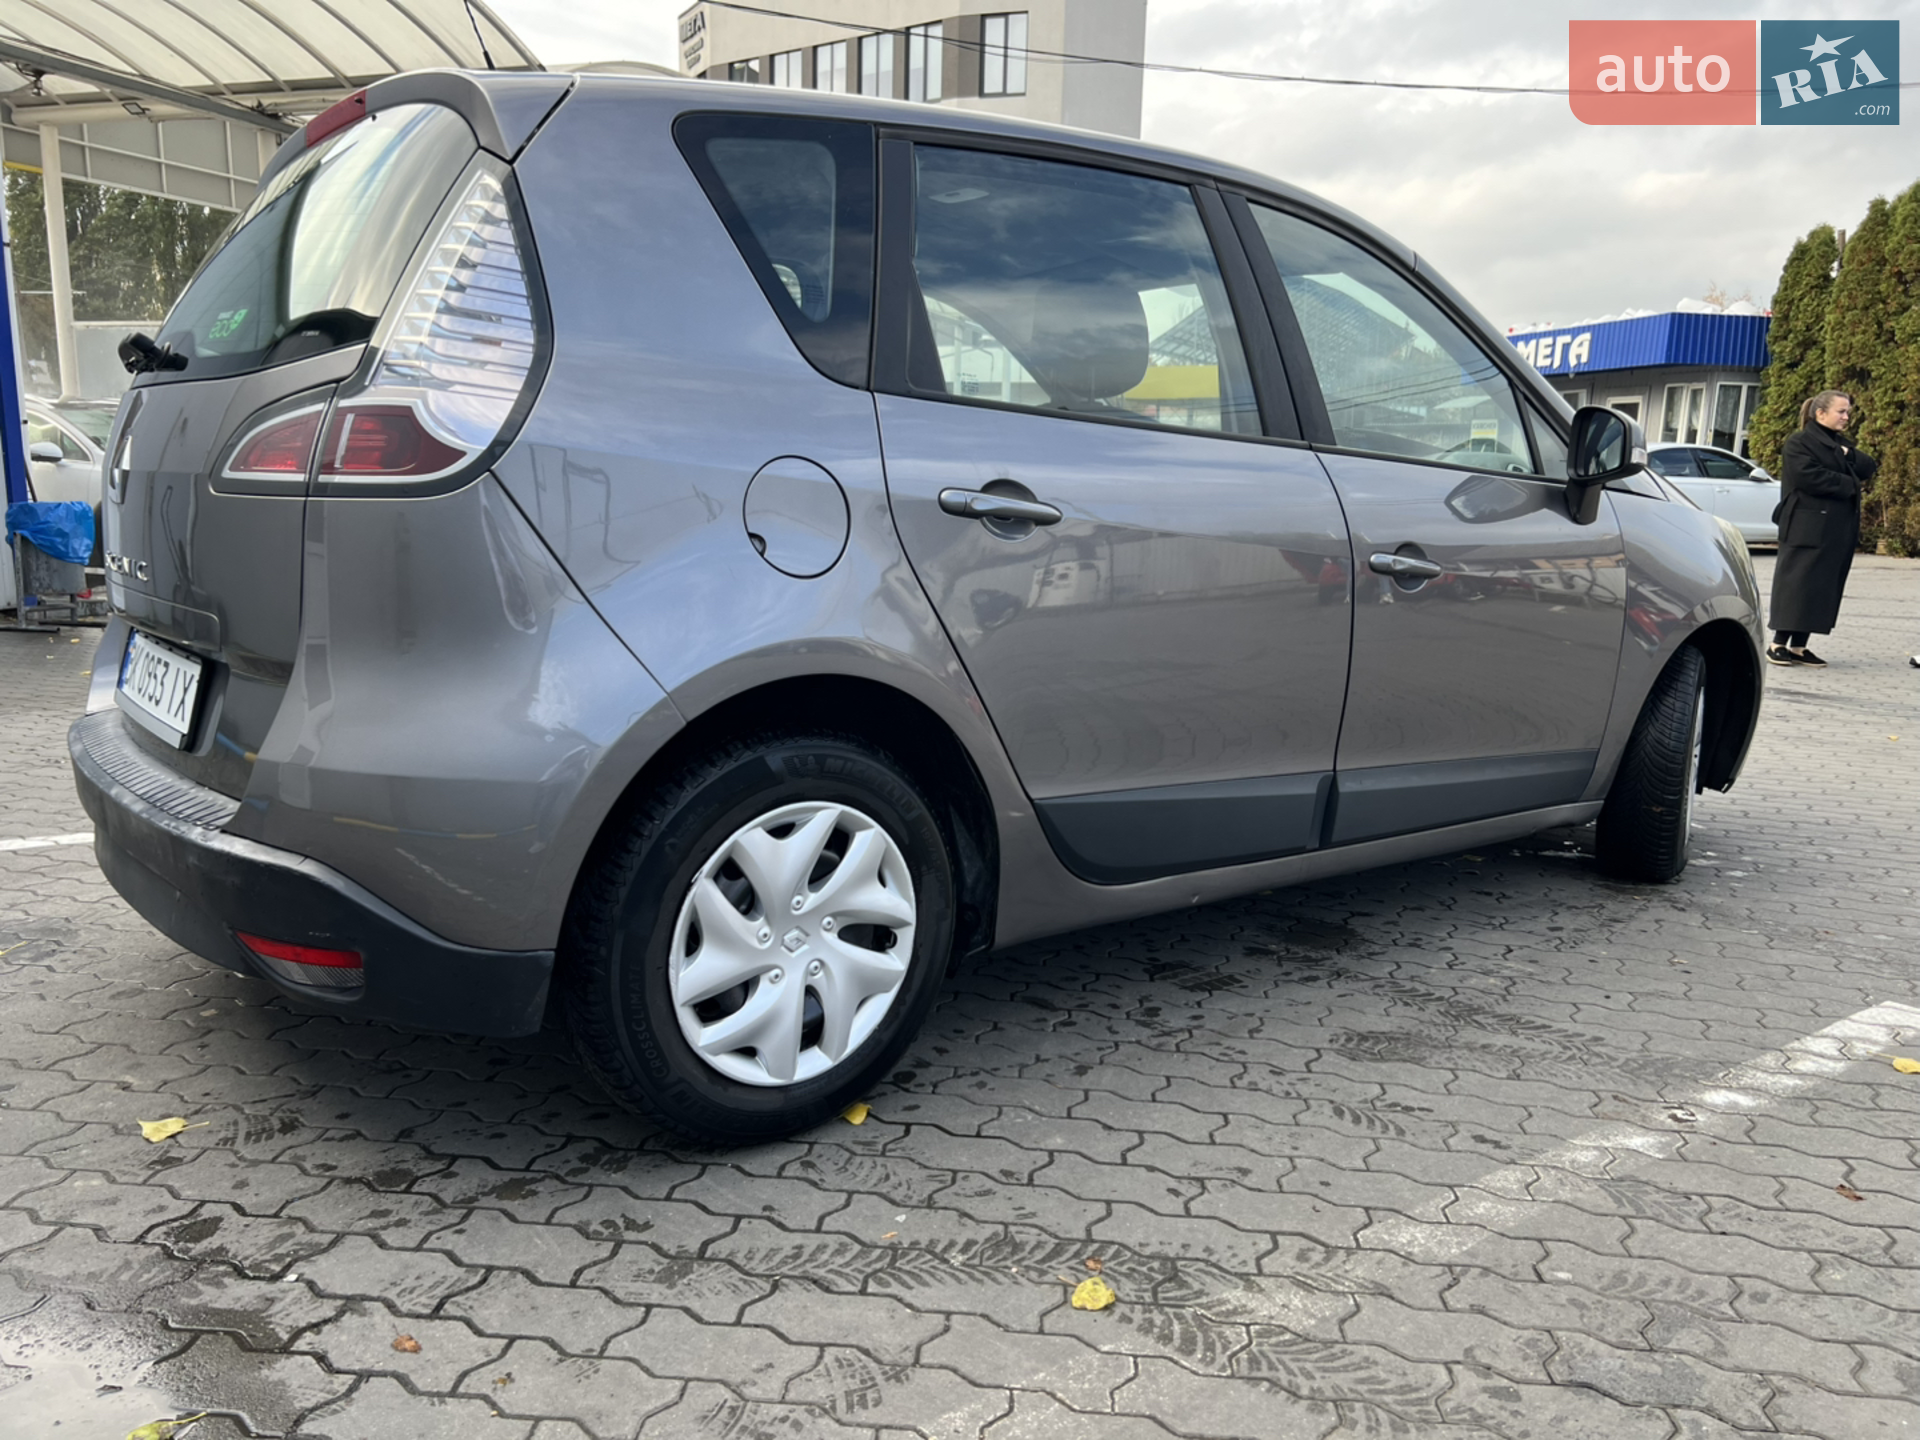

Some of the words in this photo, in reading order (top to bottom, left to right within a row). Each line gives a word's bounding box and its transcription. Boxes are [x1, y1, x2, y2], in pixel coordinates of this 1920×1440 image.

[1516, 332, 1591, 369] МЕГА
[138, 651, 170, 706] 0953
[167, 667, 195, 722] IX
[824, 757, 922, 821] MICHELIN
